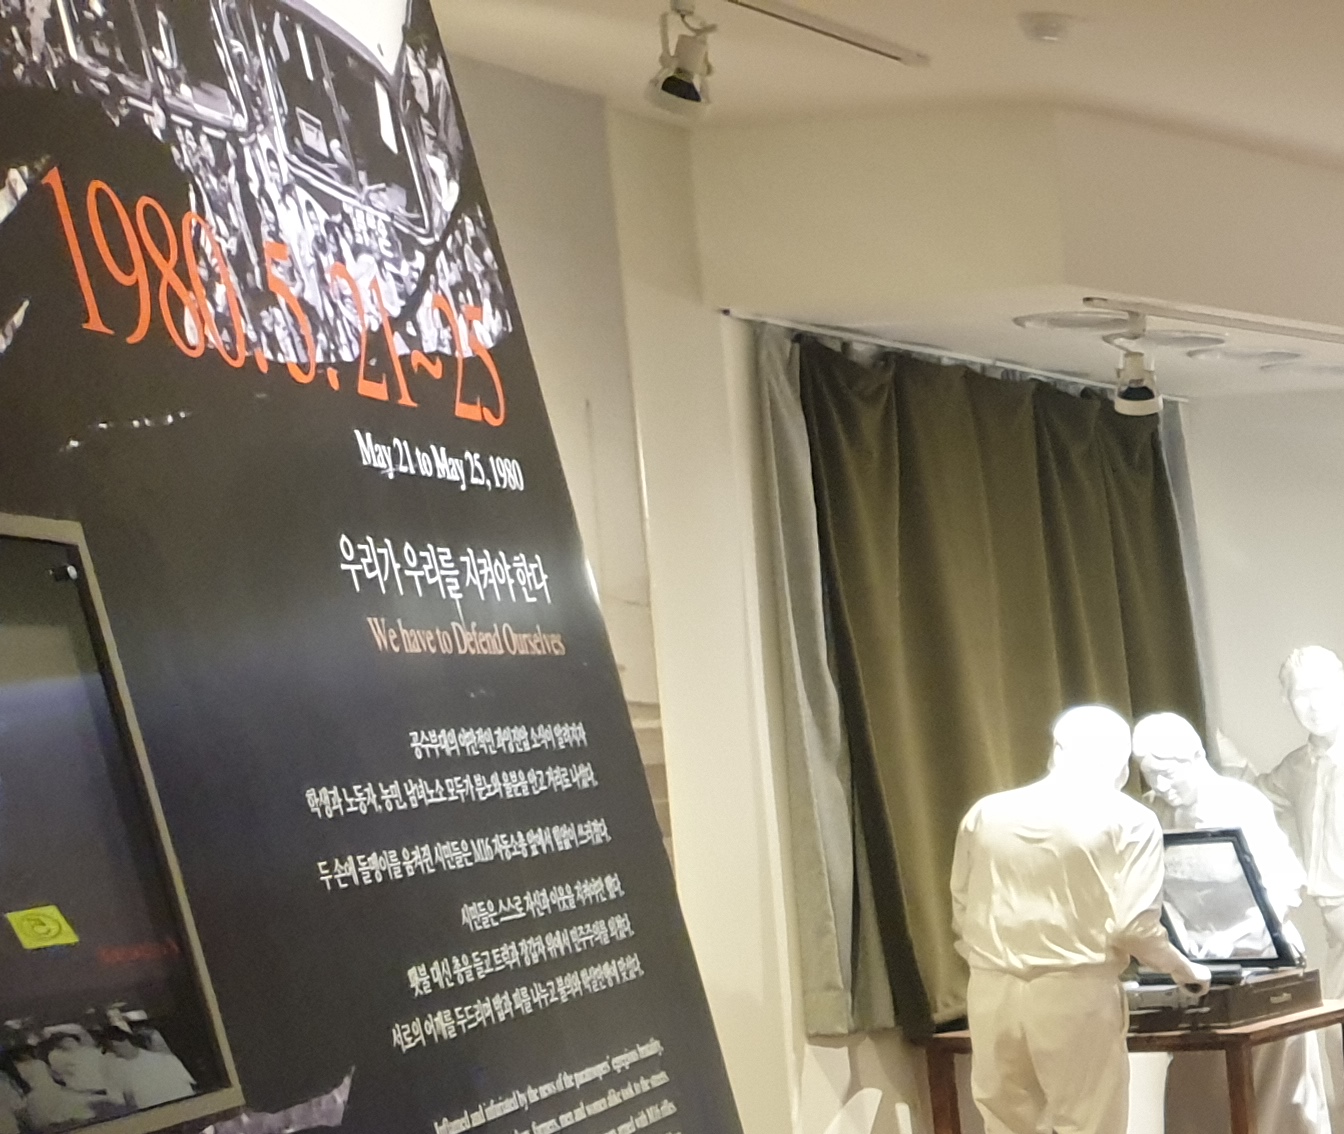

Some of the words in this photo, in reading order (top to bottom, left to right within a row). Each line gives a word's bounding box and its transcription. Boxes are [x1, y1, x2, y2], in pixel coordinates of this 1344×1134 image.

[354, 429, 394, 480] May
[393, 437, 415, 475] 21
[415, 447, 433, 477] to
[430, 444, 466, 491] May
[464, 450, 492, 491] 25,
[490, 455, 524, 491] 1980
[339, 534, 404, 596] 우리가
[404, 542, 463, 599] 우리를
[460, 547, 517, 602] 지켜야
[513, 552, 551, 604] 한다
[366, 617, 400, 652] We
[397, 618, 436, 654] have
[436, 627, 453, 654] to
[450, 621, 504, 655] Defend
[502, 622, 565, 656] Ourselves
[409, 728, 461, 759] 공수부대의
[342, 782, 380, 815] 노동자,
[403, 778, 447, 809] 남녀노소
[444, 774, 475, 802] 모두가
[317, 861, 333, 890] 두
[334, 855, 359, 888] 손에
[434, 839, 474, 870] 시민들은
[461, 899, 499, 931] 시민들은
[498, 895, 529, 922] 스스로
[429, 958, 455, 989] 대신
[452, 954, 475, 985] 총을
[471, 951, 494, 979] 들고
[392, 1017, 426, 1053] 서로의
[528, 981, 557, 1009] 나누고
